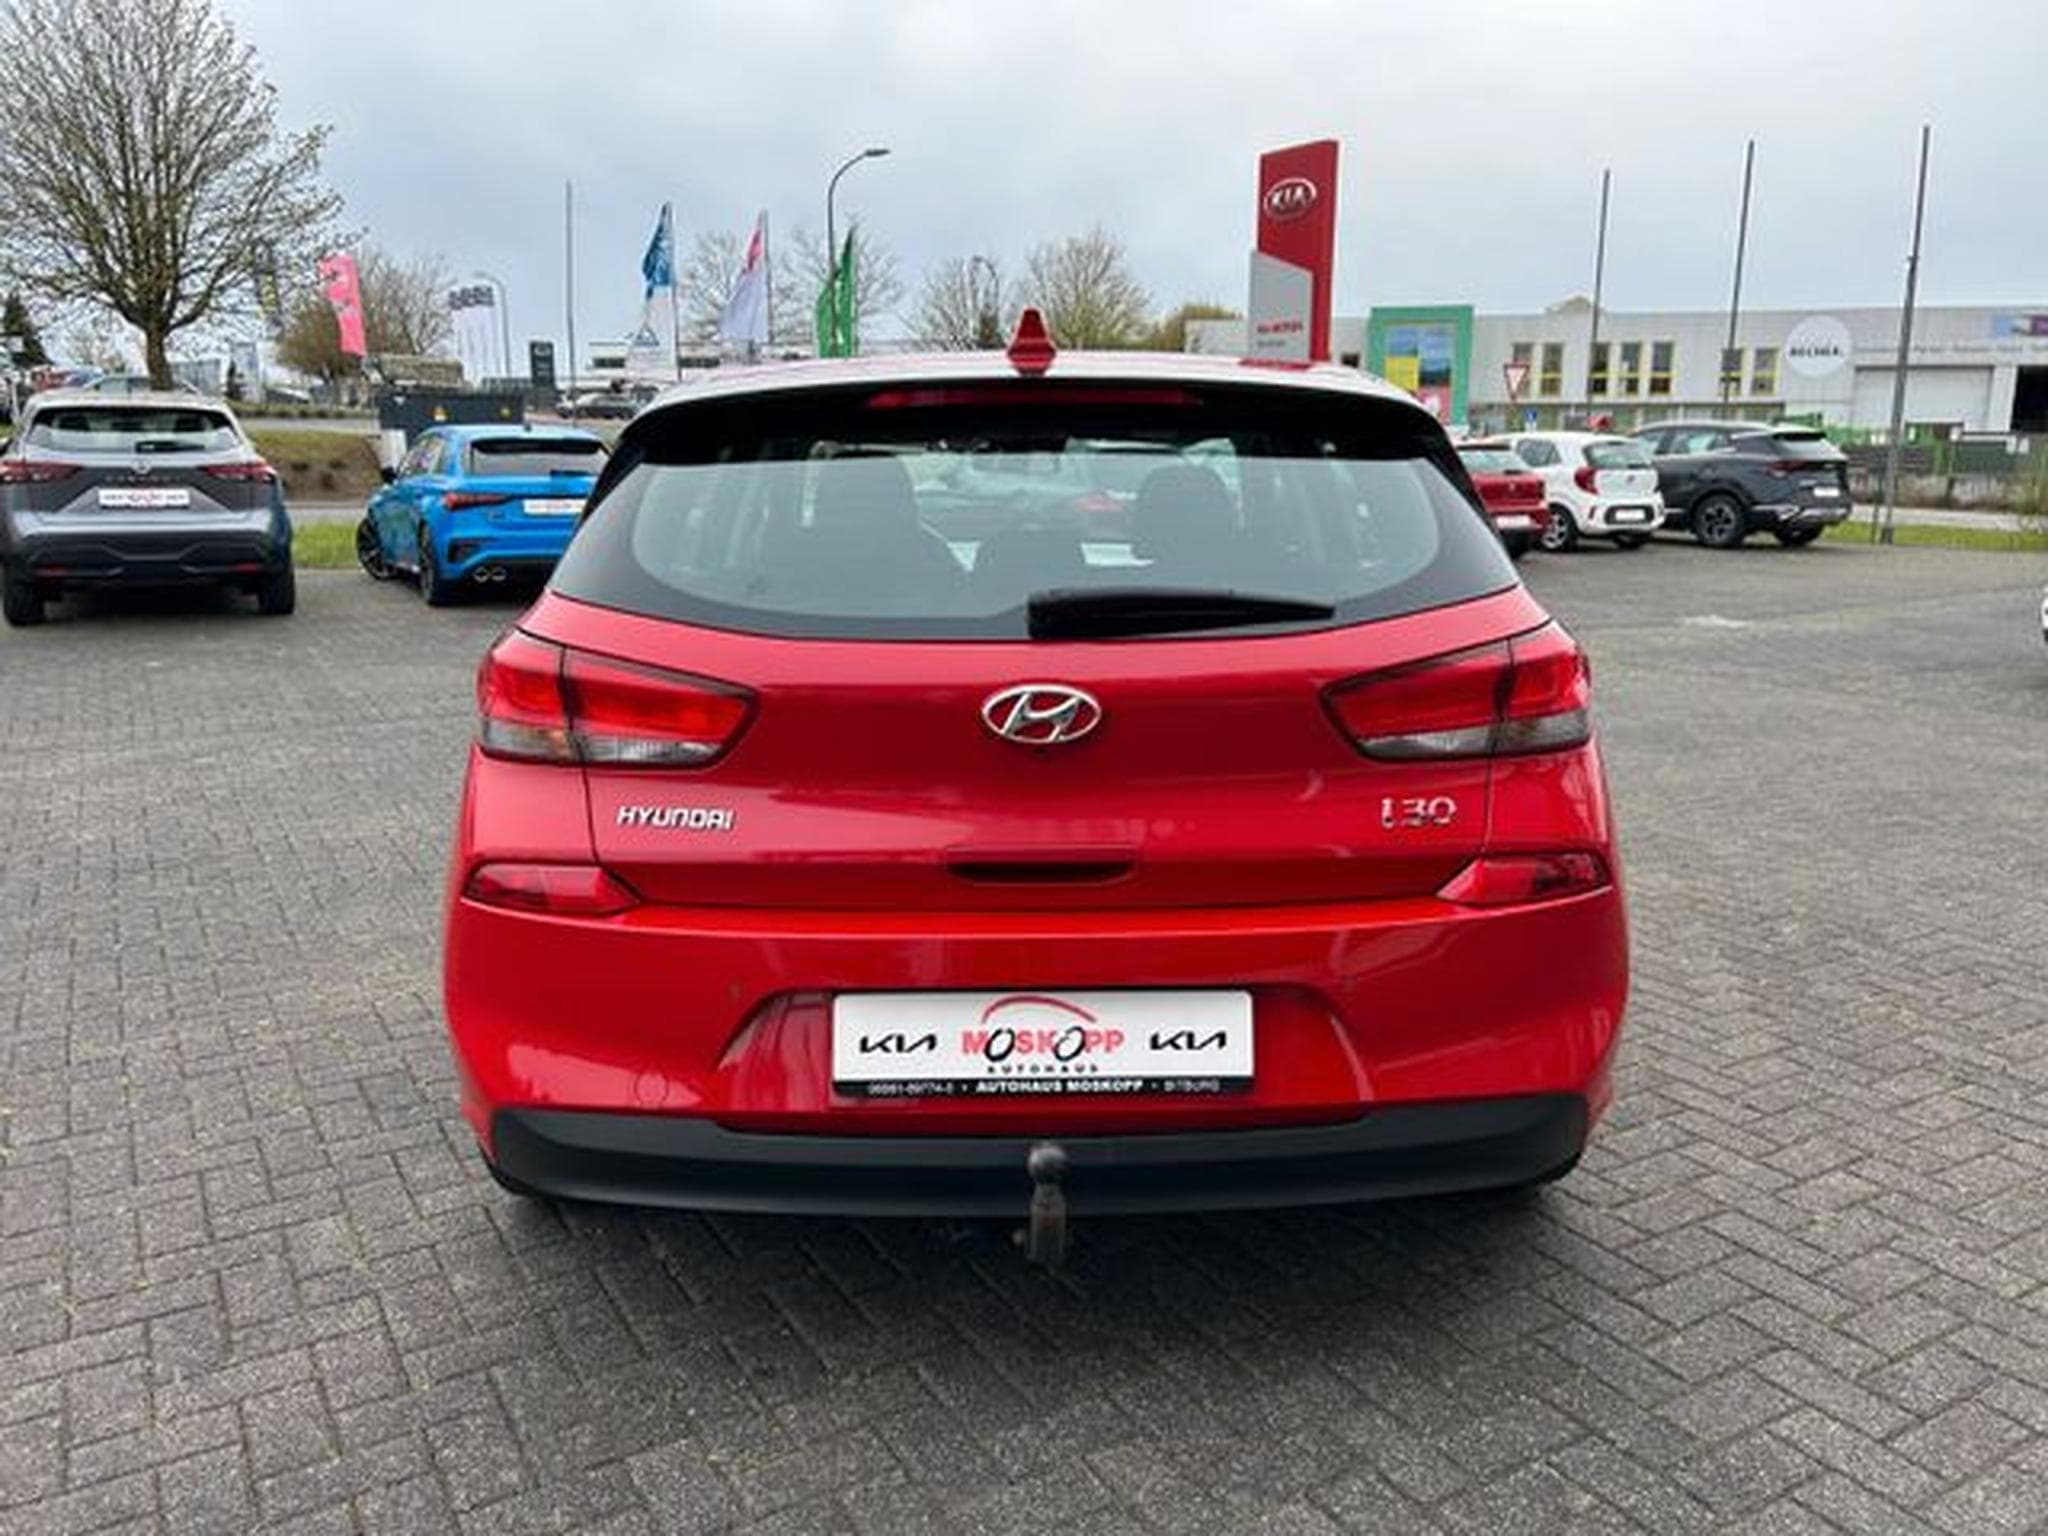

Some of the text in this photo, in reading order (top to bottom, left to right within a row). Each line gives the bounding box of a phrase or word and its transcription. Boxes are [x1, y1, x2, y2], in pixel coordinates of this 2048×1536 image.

[1270, 185, 1308, 210] KIA
[616, 805, 734, 831] HYUNDAI
[859, 1026, 1227, 1063] KIA MOSKOPP KIA
[986, 1064, 1099, 1075] AUTOHAUS
[975, 1080, 1062, 1093] AUTOHAUS
[1066, 1079, 1143, 1093] MOSKOPP
